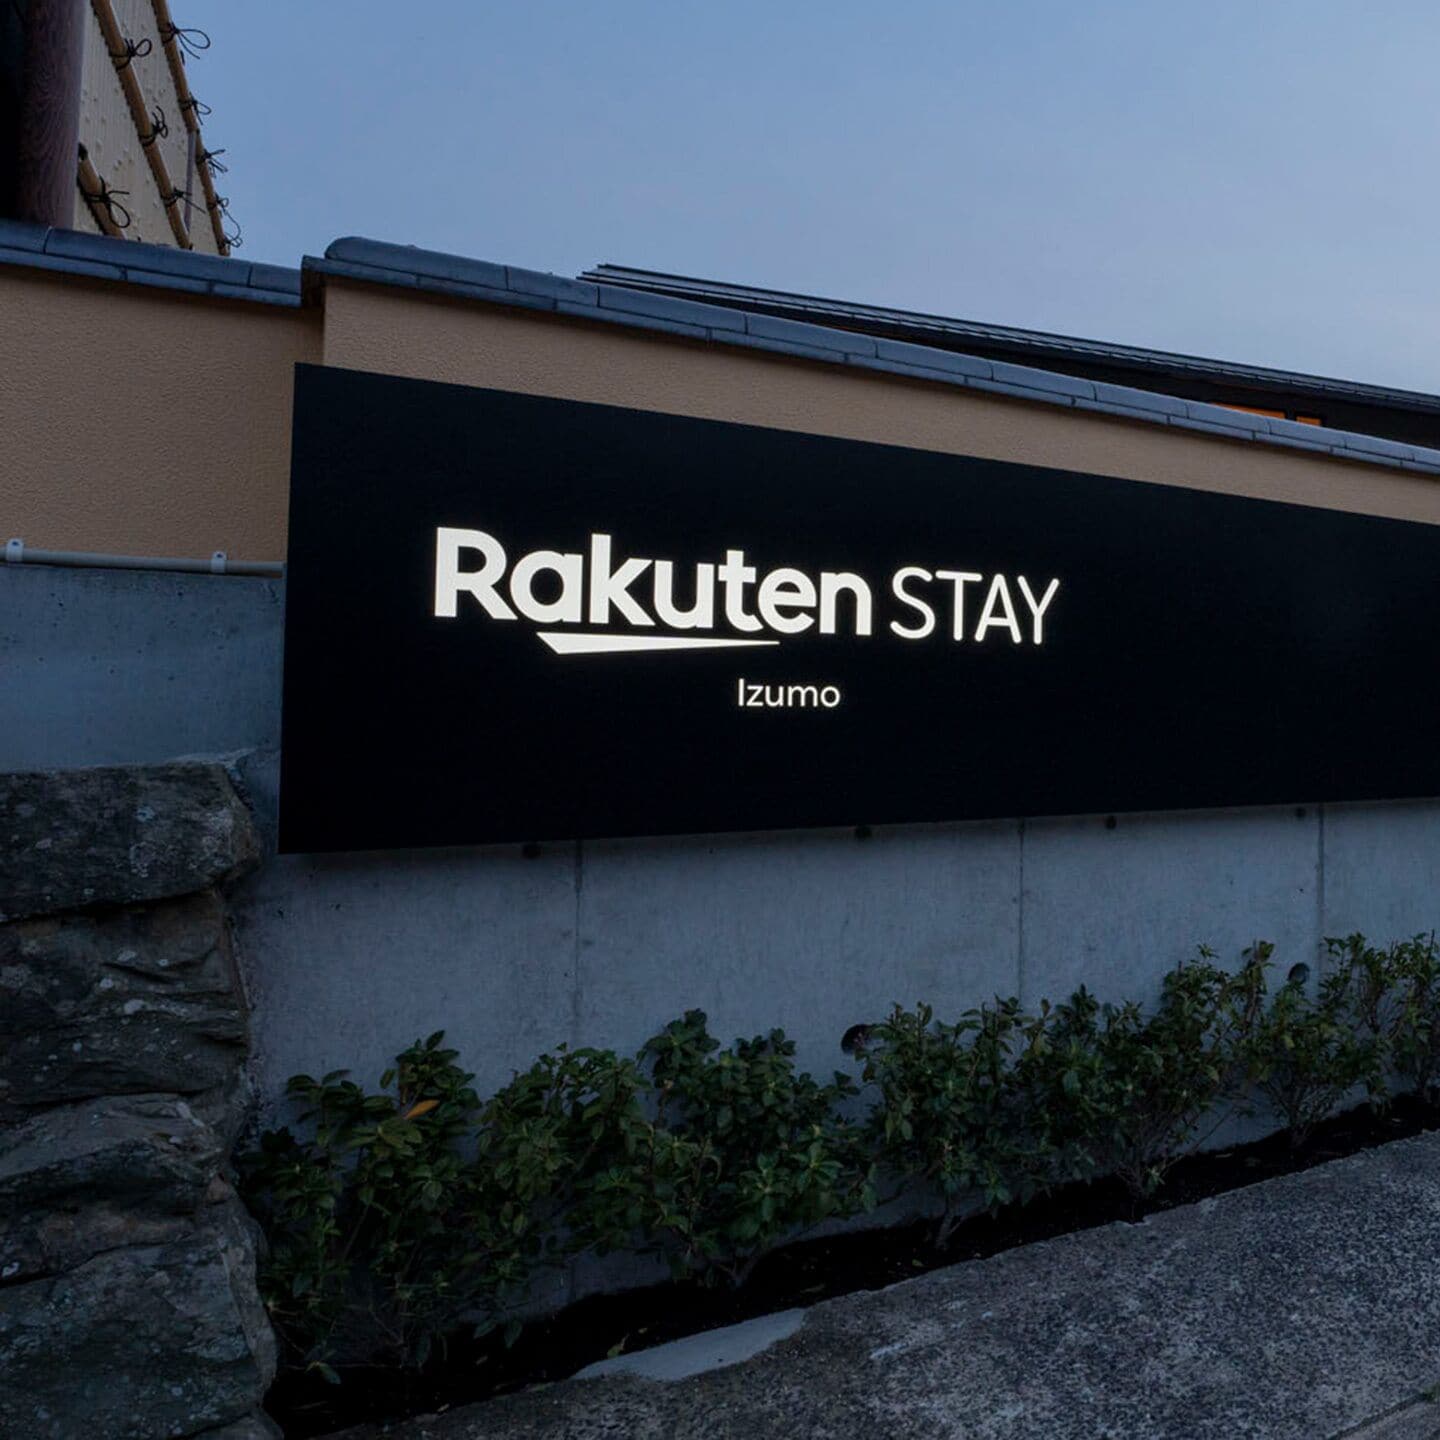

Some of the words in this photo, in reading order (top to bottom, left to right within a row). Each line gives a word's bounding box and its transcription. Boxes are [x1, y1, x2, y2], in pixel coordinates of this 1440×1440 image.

[434, 527, 873, 636] Rakuten
[889, 566, 1060, 646] STAY
[737, 677, 841, 708] Izumo
